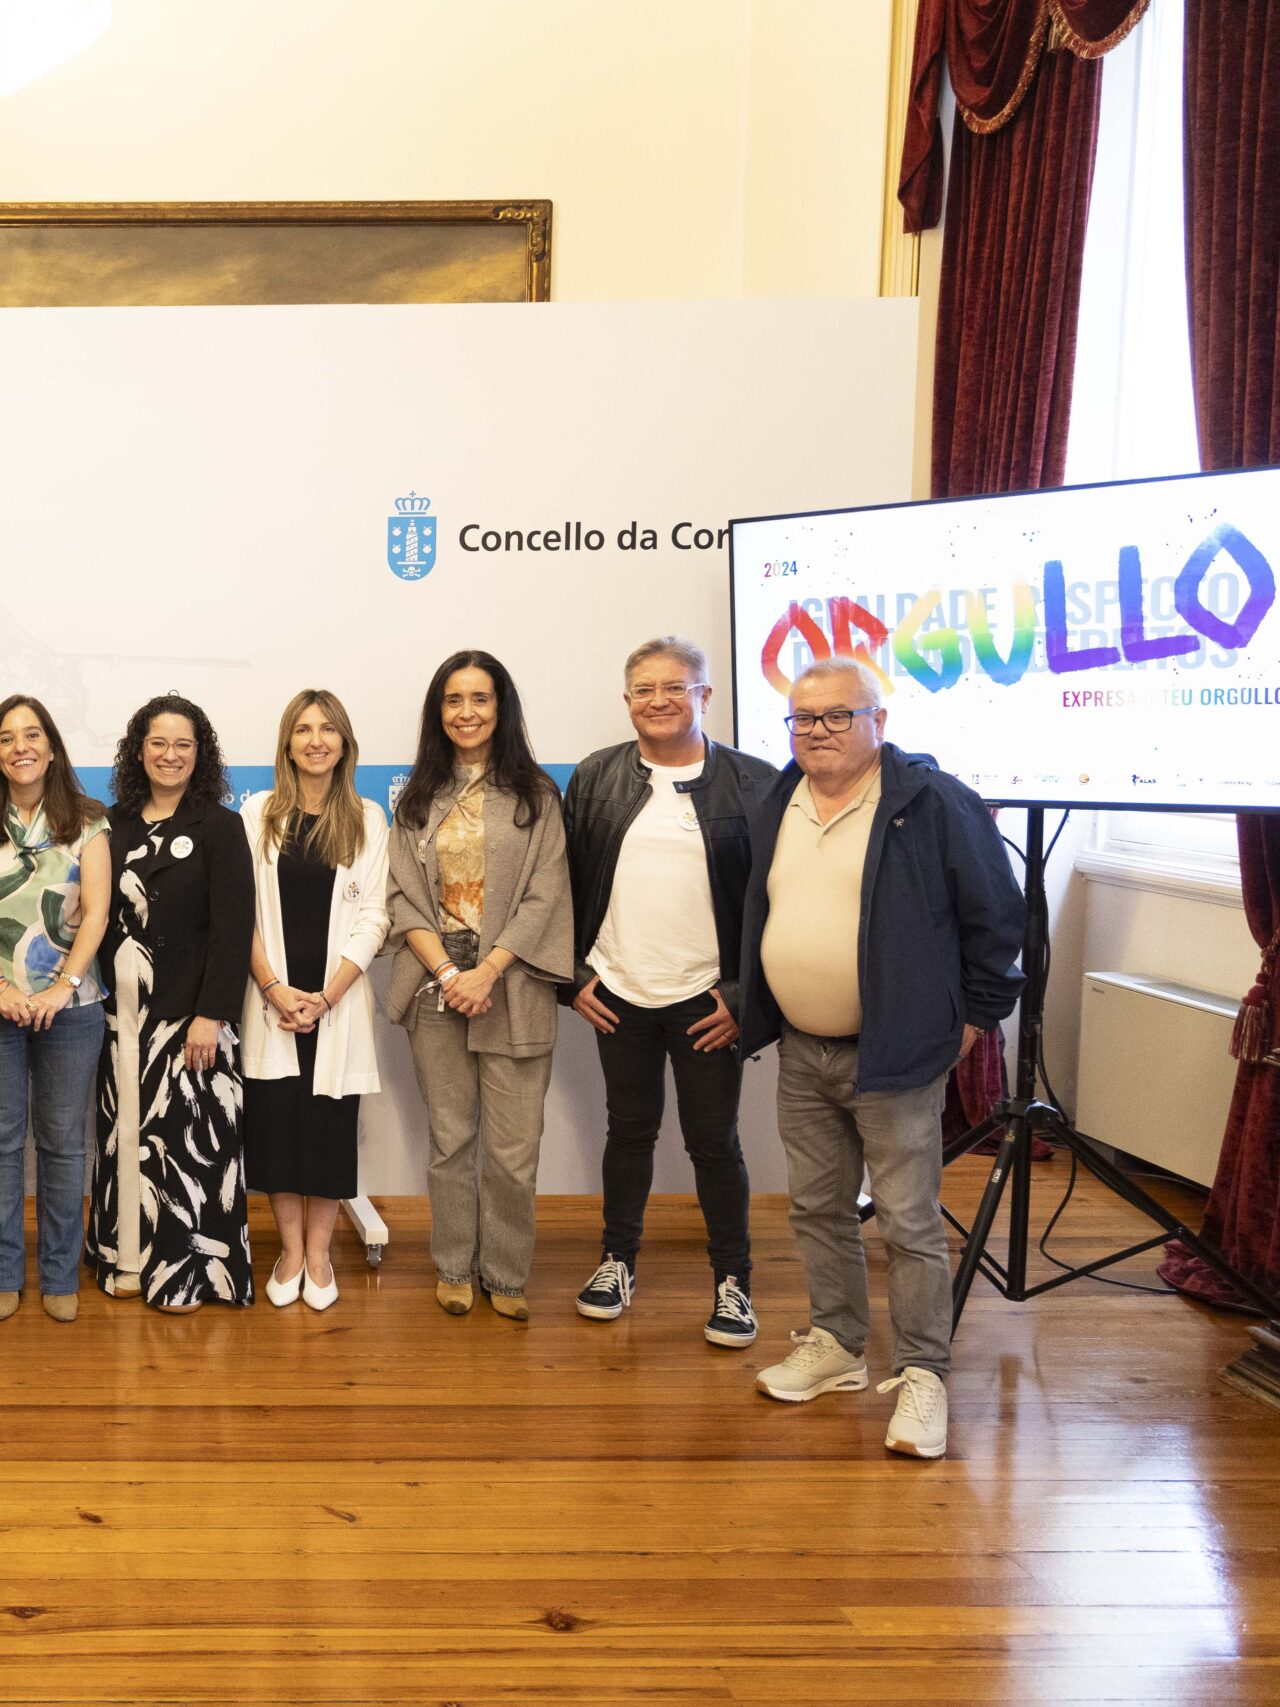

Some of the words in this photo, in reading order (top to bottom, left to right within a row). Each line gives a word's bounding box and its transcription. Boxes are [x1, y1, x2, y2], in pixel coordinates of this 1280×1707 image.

[458, 520, 605, 552] Concello
[616, 520, 658, 550] da
[670, 521, 729, 550] Cor
[764, 560, 798, 577] 2024
[761, 522, 1276, 698] ORGULLO
[1062, 688, 1136, 708] EXPRESA
[1163, 687, 1193, 706] TEU
